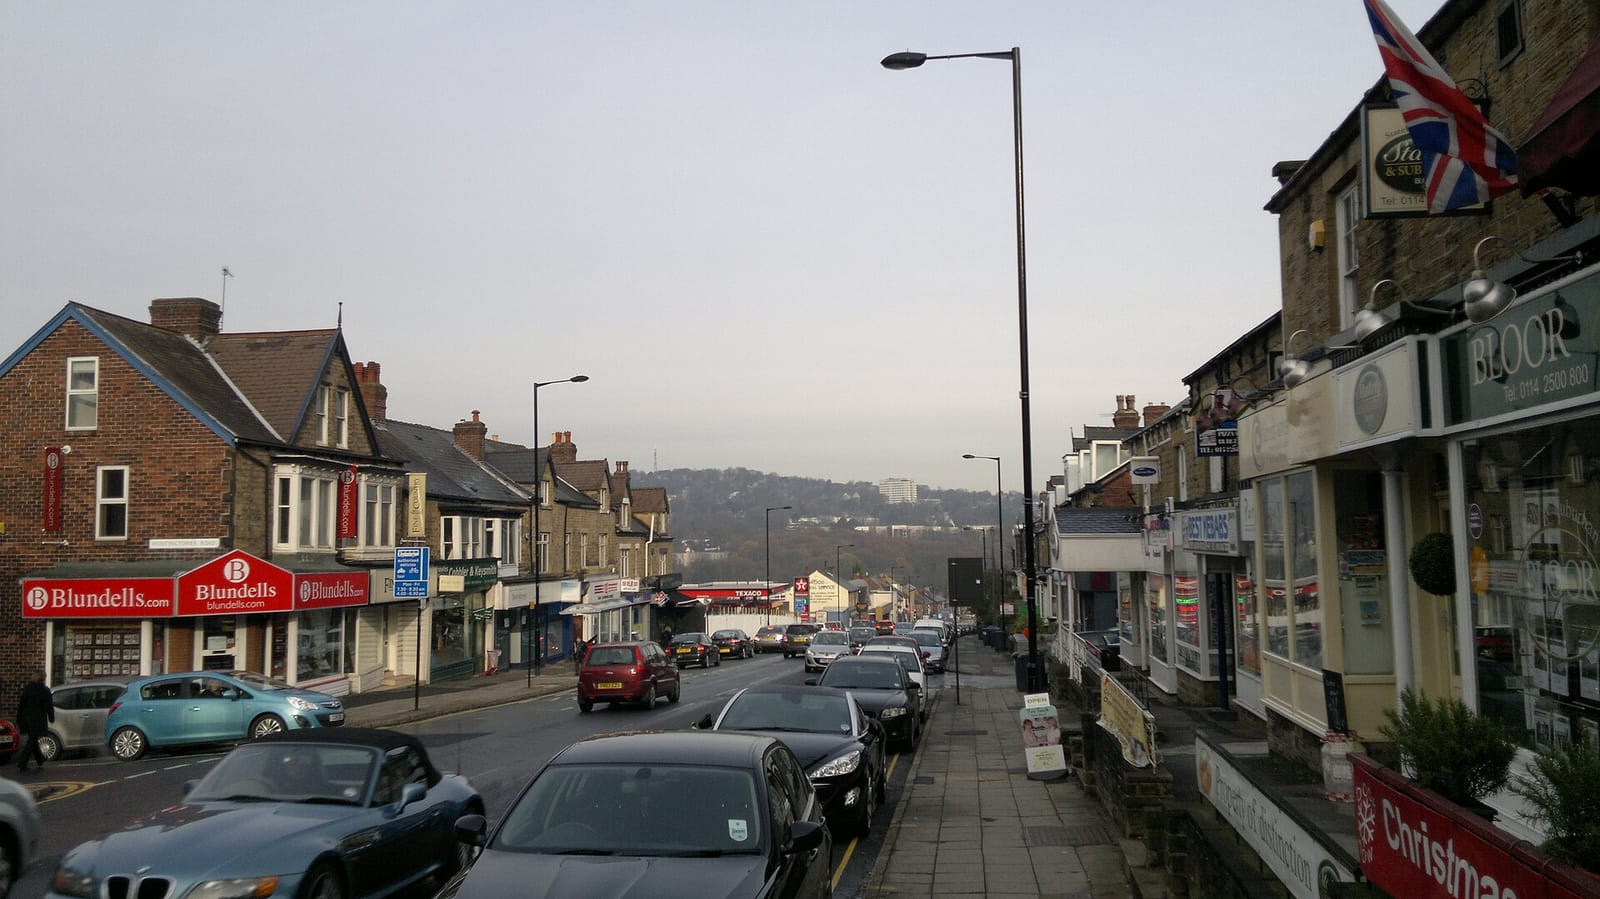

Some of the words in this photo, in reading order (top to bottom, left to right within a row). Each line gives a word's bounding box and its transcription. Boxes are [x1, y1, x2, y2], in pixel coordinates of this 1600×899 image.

[1383, 139, 1422, 163] Sta
[1398, 165, 1423, 176] SUB
[1471, 308, 1571, 386] BLOOR
[1520, 378, 1540, 399] 0114
[1543, 369, 1567, 393] 2500
[1569, 363, 1589, 386] 800
[342, 484, 351, 534] blundells.com
[1187, 515, 1202, 539] BEST
[230, 561, 246, 581] B
[32, 589, 45, 608] B
[51, 587, 169, 609] Blundells.com
[195, 582, 277, 600] Blundells
[206, 600, 265, 610] blundells.com
[1027, 697, 1047, 705] OPEN
[1215, 765, 1246, 819] Property
[1247, 798, 1257, 832] of
[1259, 806, 1313, 892] distinction
